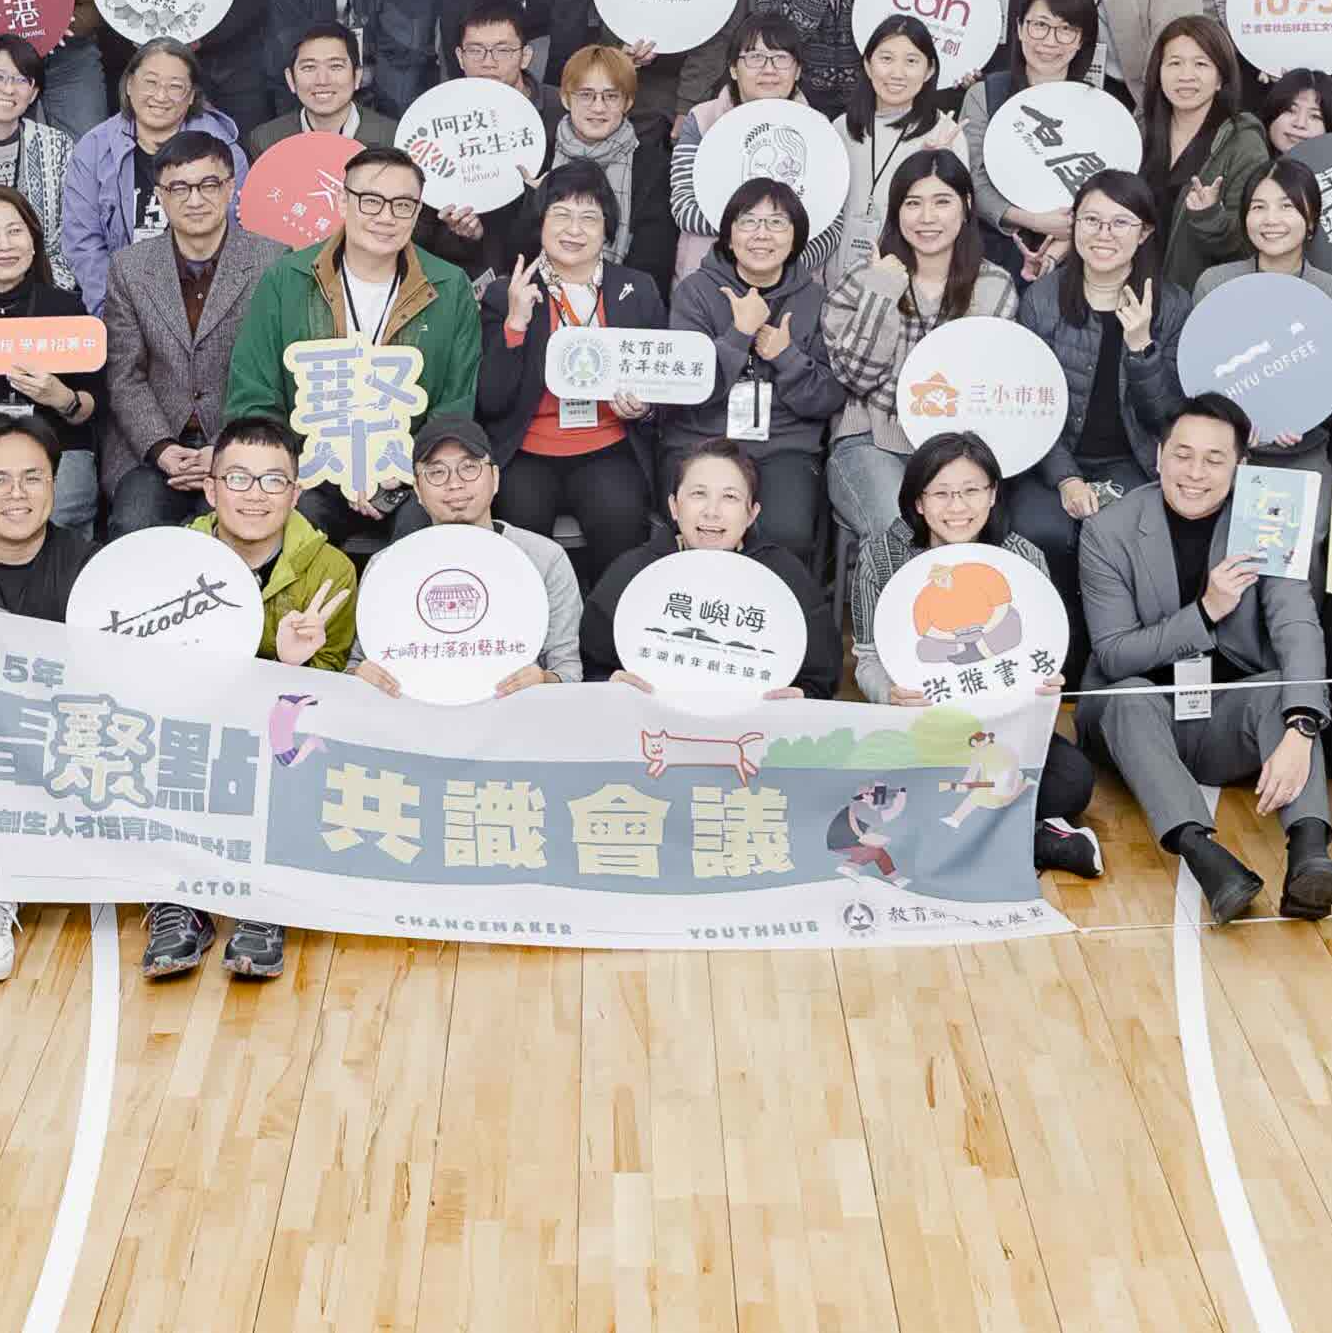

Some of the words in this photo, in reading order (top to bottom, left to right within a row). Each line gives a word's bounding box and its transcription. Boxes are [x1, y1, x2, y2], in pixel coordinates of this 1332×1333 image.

[431, 109, 488, 139] 阿改
[457, 127, 534, 158] 玩生活
[618, 338, 673, 358] 教育部
[1263, 342, 1319, 379] COFFEE
[617, 358, 705, 378] 青年發展署
[969, 384, 1057, 406] 三小市集
[293, 346, 418, 492] 聚
[661, 591, 766, 633] 農嶼海
[321, 761, 795, 879] 共識會議
[175, 880, 252, 896] ACTOR
[395, 913, 573, 936] CHANGEMAKER
[689, 920, 819, 939] YOUTHHUB
